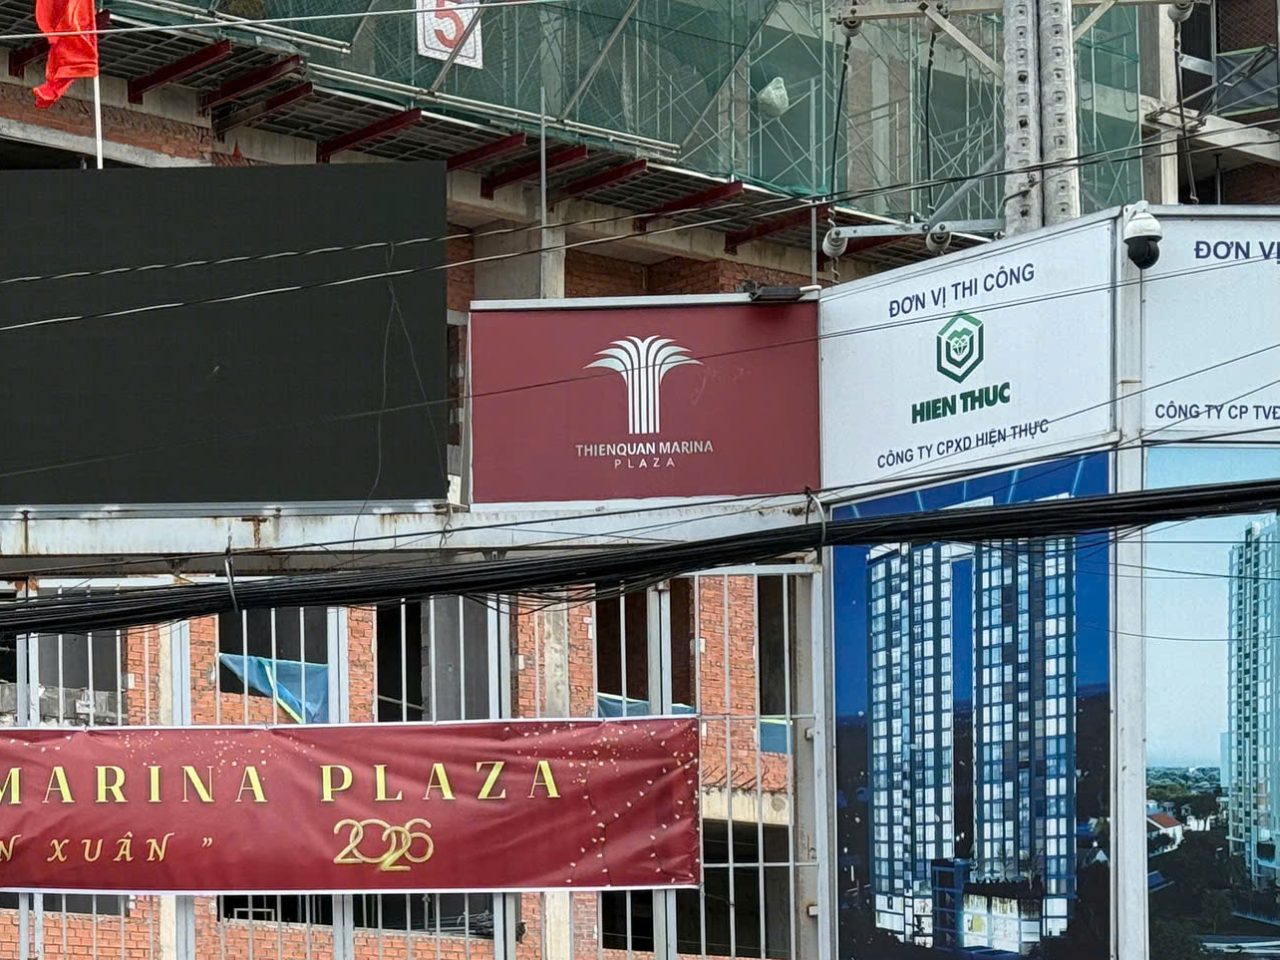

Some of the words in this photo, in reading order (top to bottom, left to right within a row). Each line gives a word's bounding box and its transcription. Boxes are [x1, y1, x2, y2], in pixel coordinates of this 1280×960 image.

[1194, 240, 1250, 260] ĐƠN
[889, 291, 926, 318] ĐƠN
[930, 287, 946, 308] VỊ
[951, 278, 978, 300] THI
[984, 262, 1035, 292] CÔNG
[912, 395, 956, 424] HIEN
[960, 382, 1011, 412] THUC
[1155, 400, 1200, 418] CÔNG
[1204, 405, 1224, 420] TY
[1228, 405, 1249, 420] CP
[575, 442, 656, 456] THIENQUAN
[659, 440, 714, 454] MARINA
[877, 448, 914, 469] CÔNG
[917, 443, 934, 459] TY
[937, 436, 972, 456] CPXD
[976, 427, 1006, 448] HIỆN
[1011, 418, 1049, 440] THỰC
[614, 458, 676, 469] PLAZA
[320, 760, 561, 802] PLAZA
[47, 831, 175, 862] XUÂN
[333, 818, 435, 872] 2026
